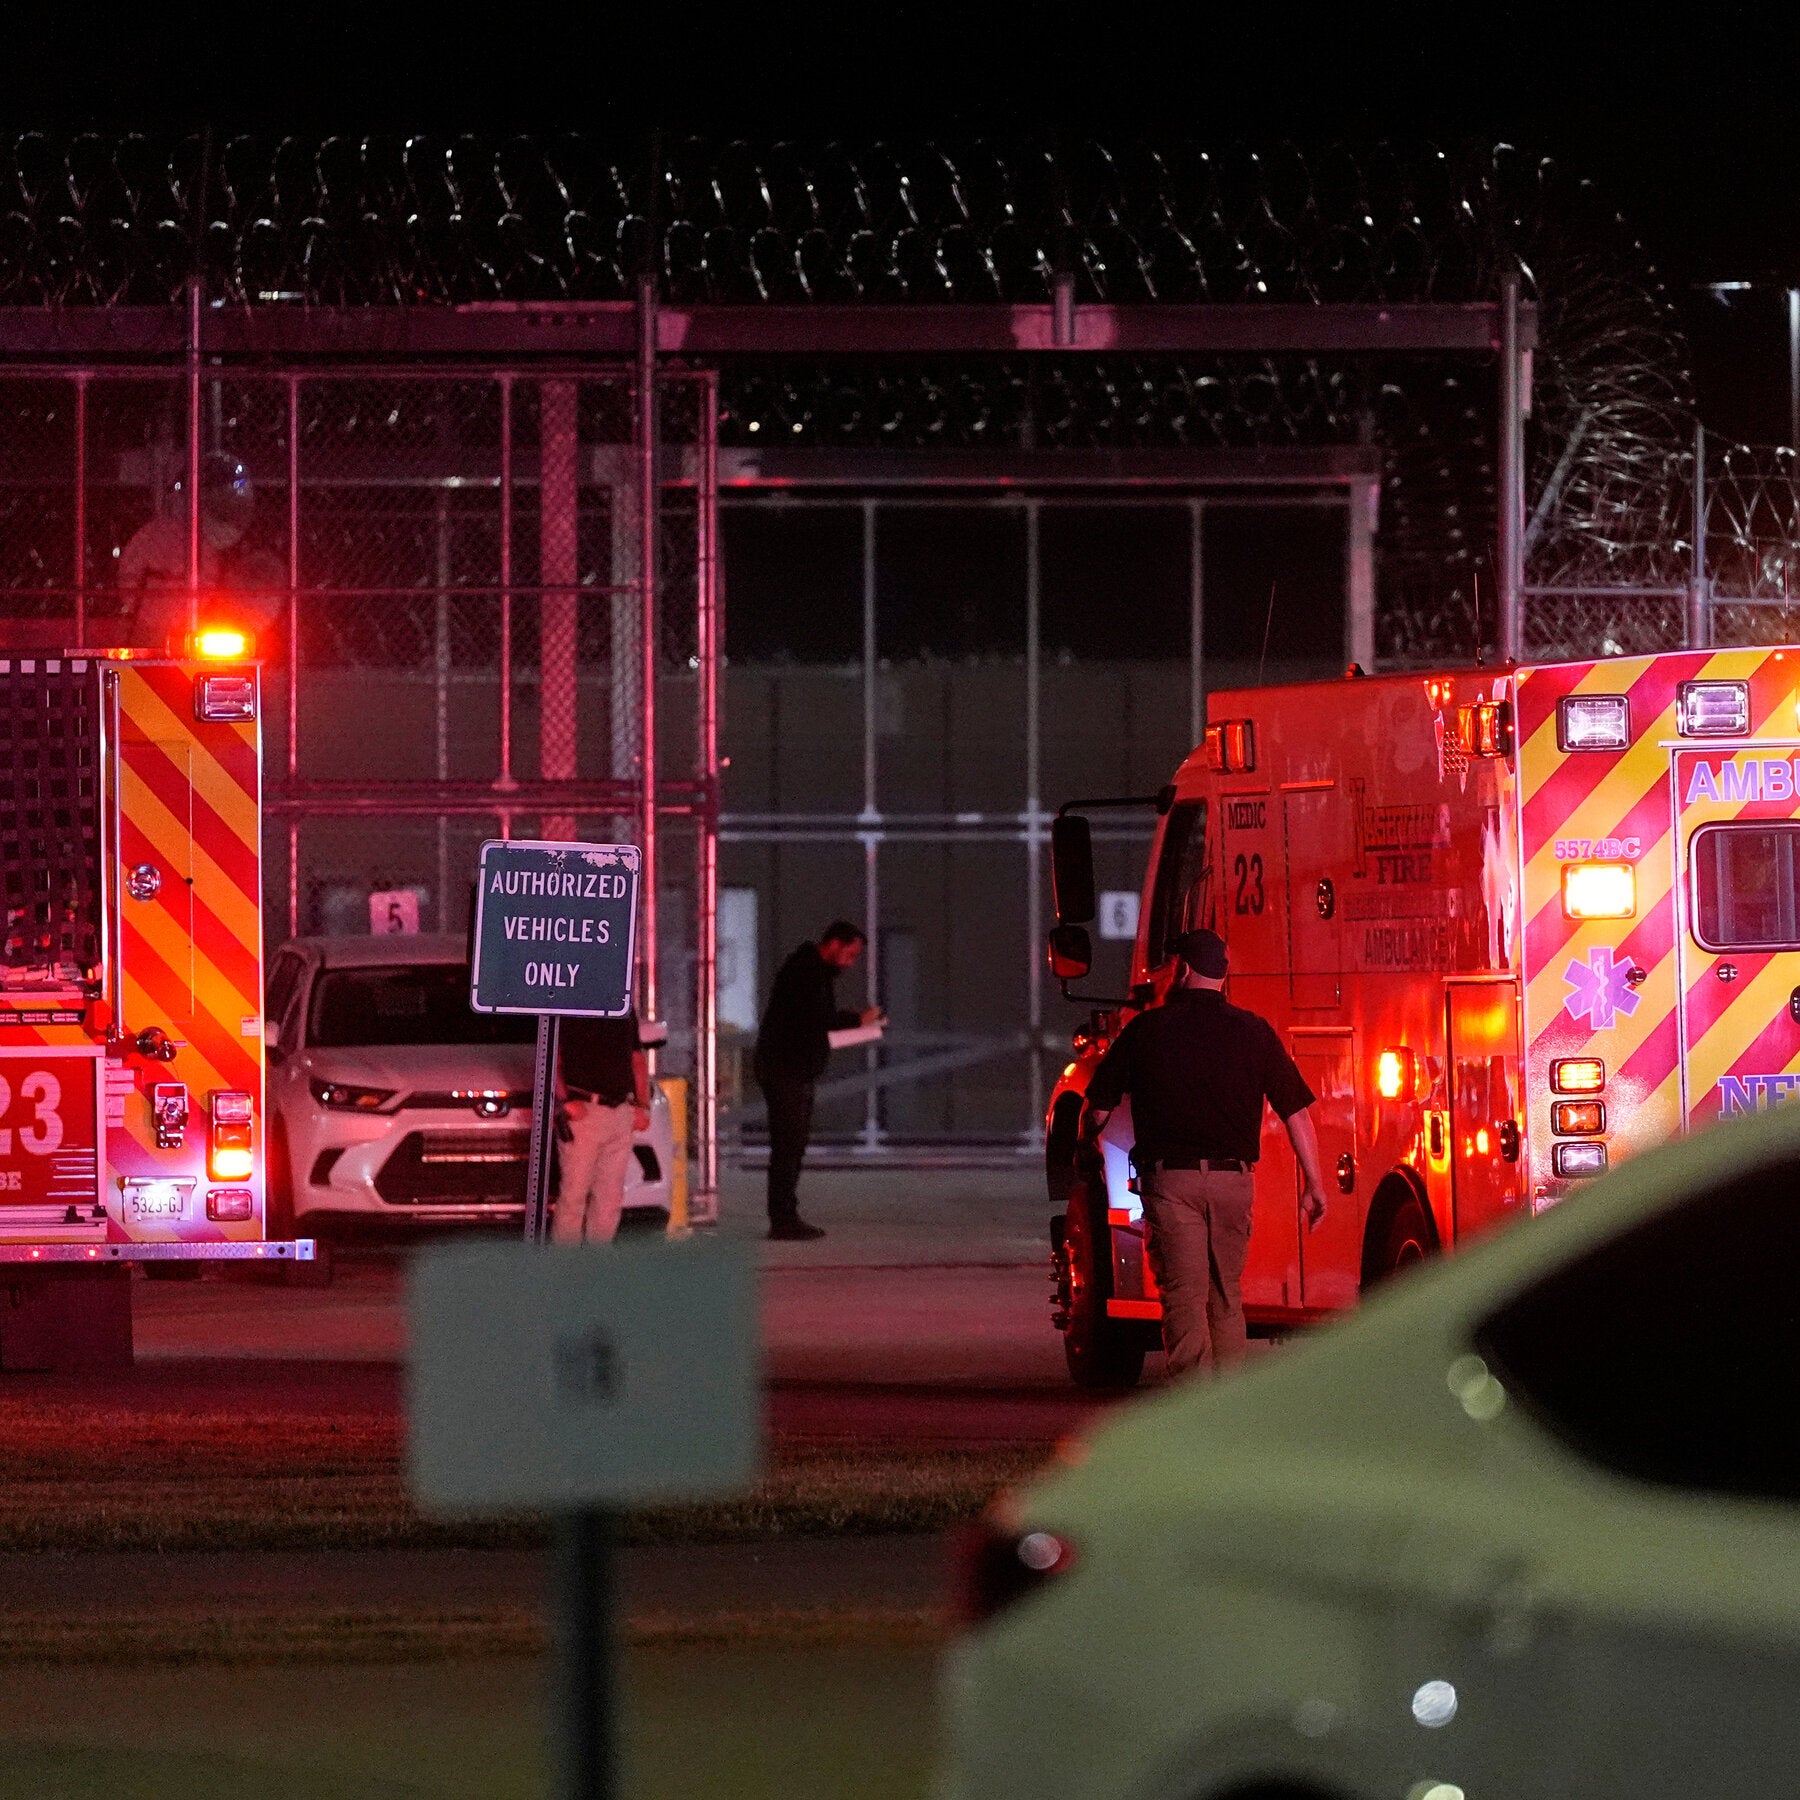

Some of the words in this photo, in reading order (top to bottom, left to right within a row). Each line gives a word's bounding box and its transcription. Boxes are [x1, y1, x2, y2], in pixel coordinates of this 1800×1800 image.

[1684, 758, 1800, 803] AMB
[1228, 802, 1266, 830] MEDIC
[1554, 837, 1641, 860] 5574BC
[1377, 854, 1432, 884] FIRE
[490, 870, 627, 899] AUTHORIZED
[1234, 853, 1265, 915] 23
[388, 903, 404, 934] 5
[503, 916, 611, 944] VEHICLES
[1364, 926, 1448, 965] AMBULANCE
[525, 961, 580, 988] ONLY
[132, 1195, 184, 1214] 5323-GJ
